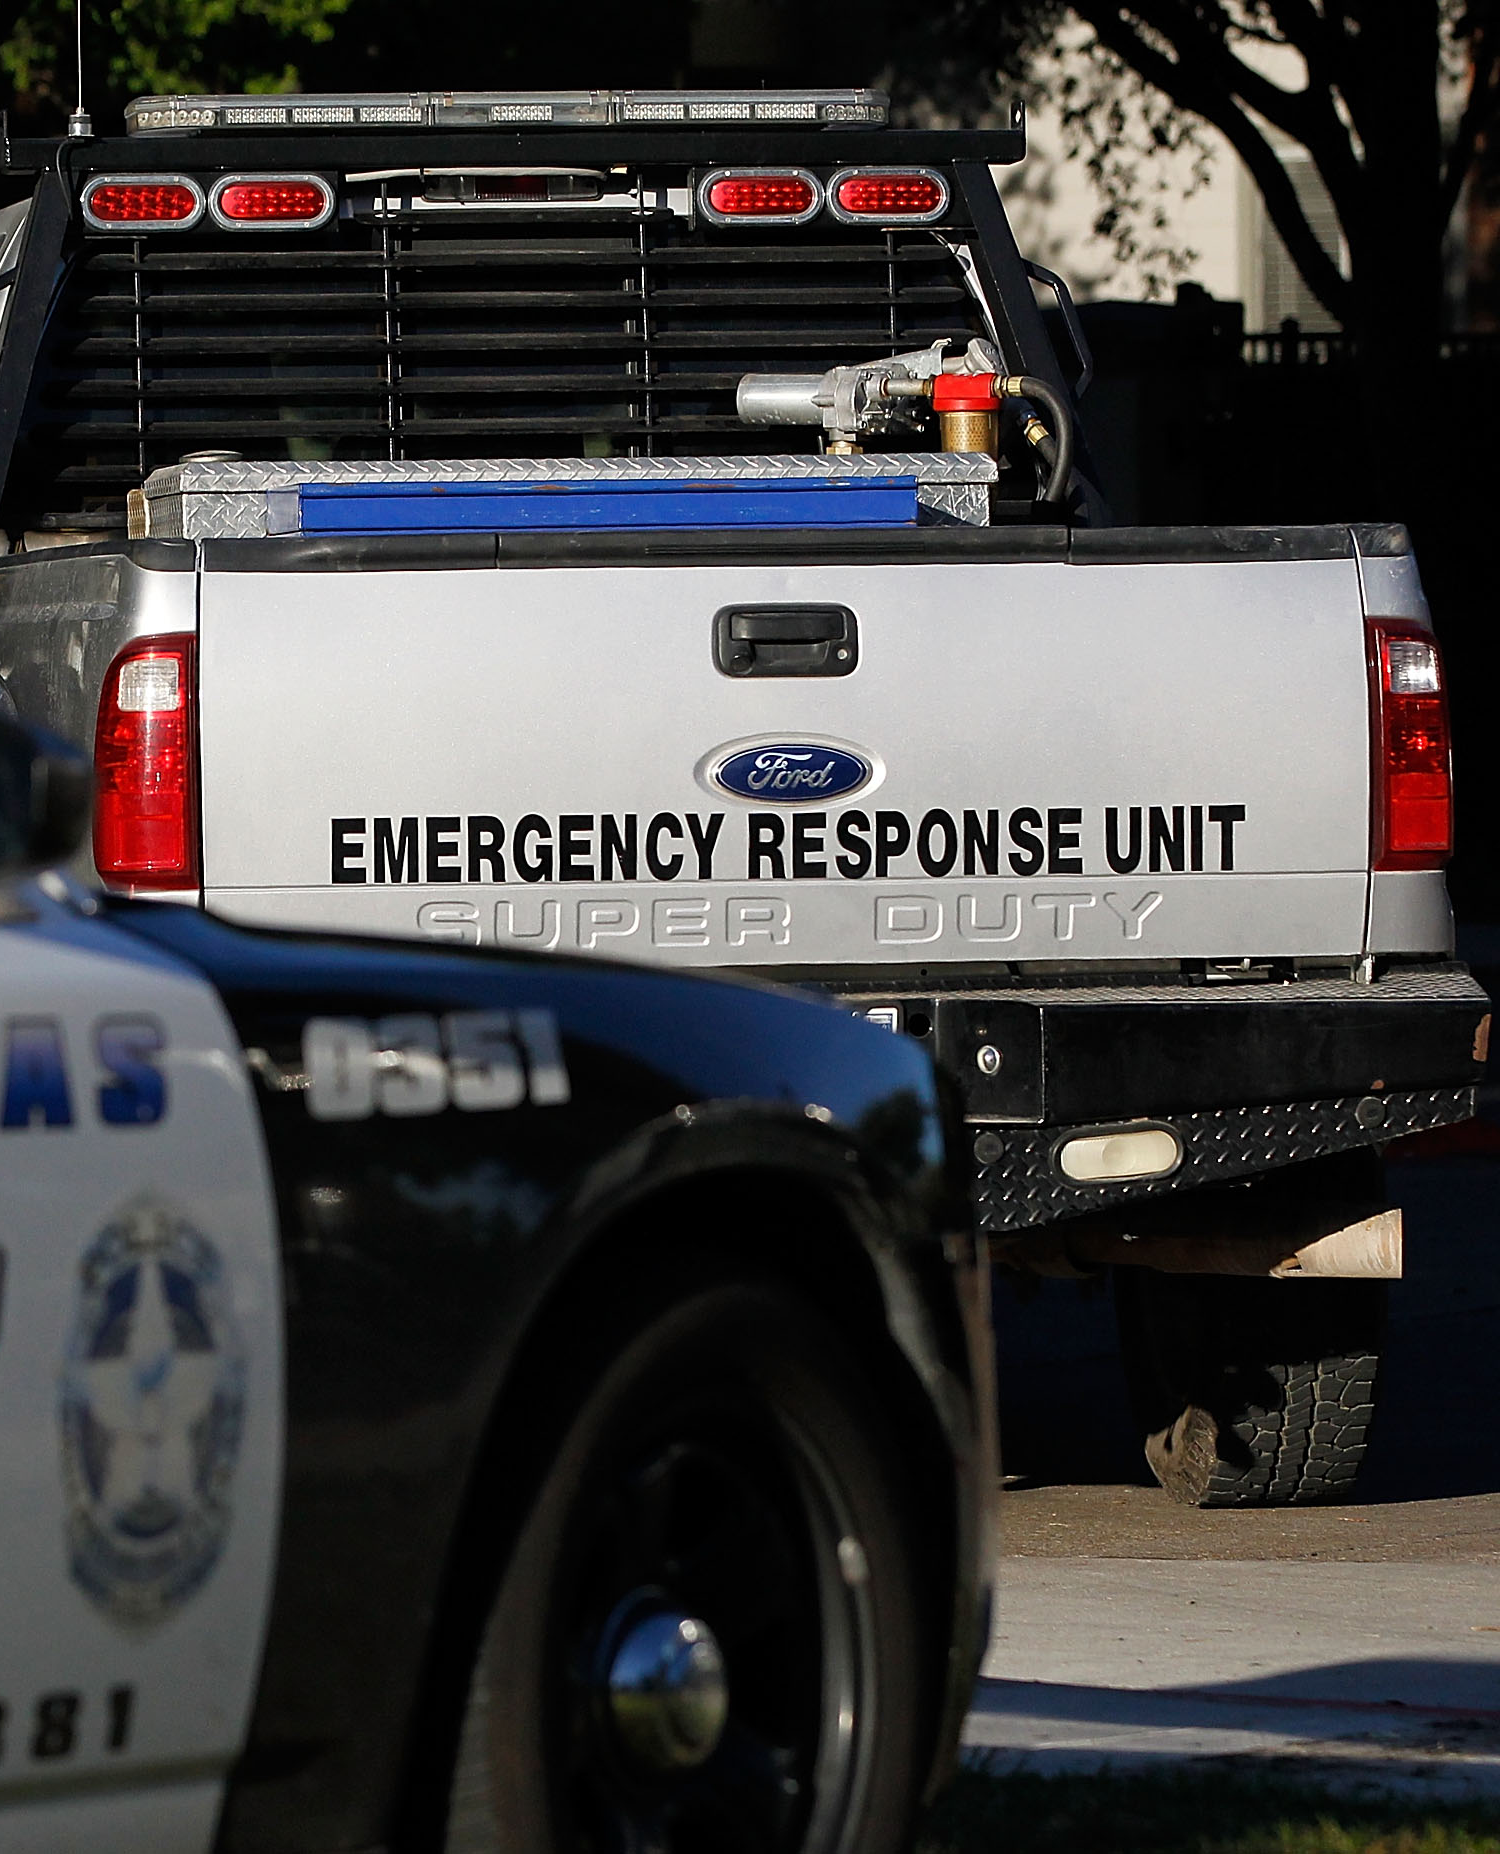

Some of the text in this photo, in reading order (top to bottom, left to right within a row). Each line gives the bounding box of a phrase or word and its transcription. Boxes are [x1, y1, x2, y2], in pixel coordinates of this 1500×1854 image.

[747, 752, 836, 790] Ford
[330, 804, 1246, 886] EMERGENCY RESPONSE UNIT
[416, 891, 1164, 950] SUPER DUTY
[300, 1008, 571, 1120] 0351
